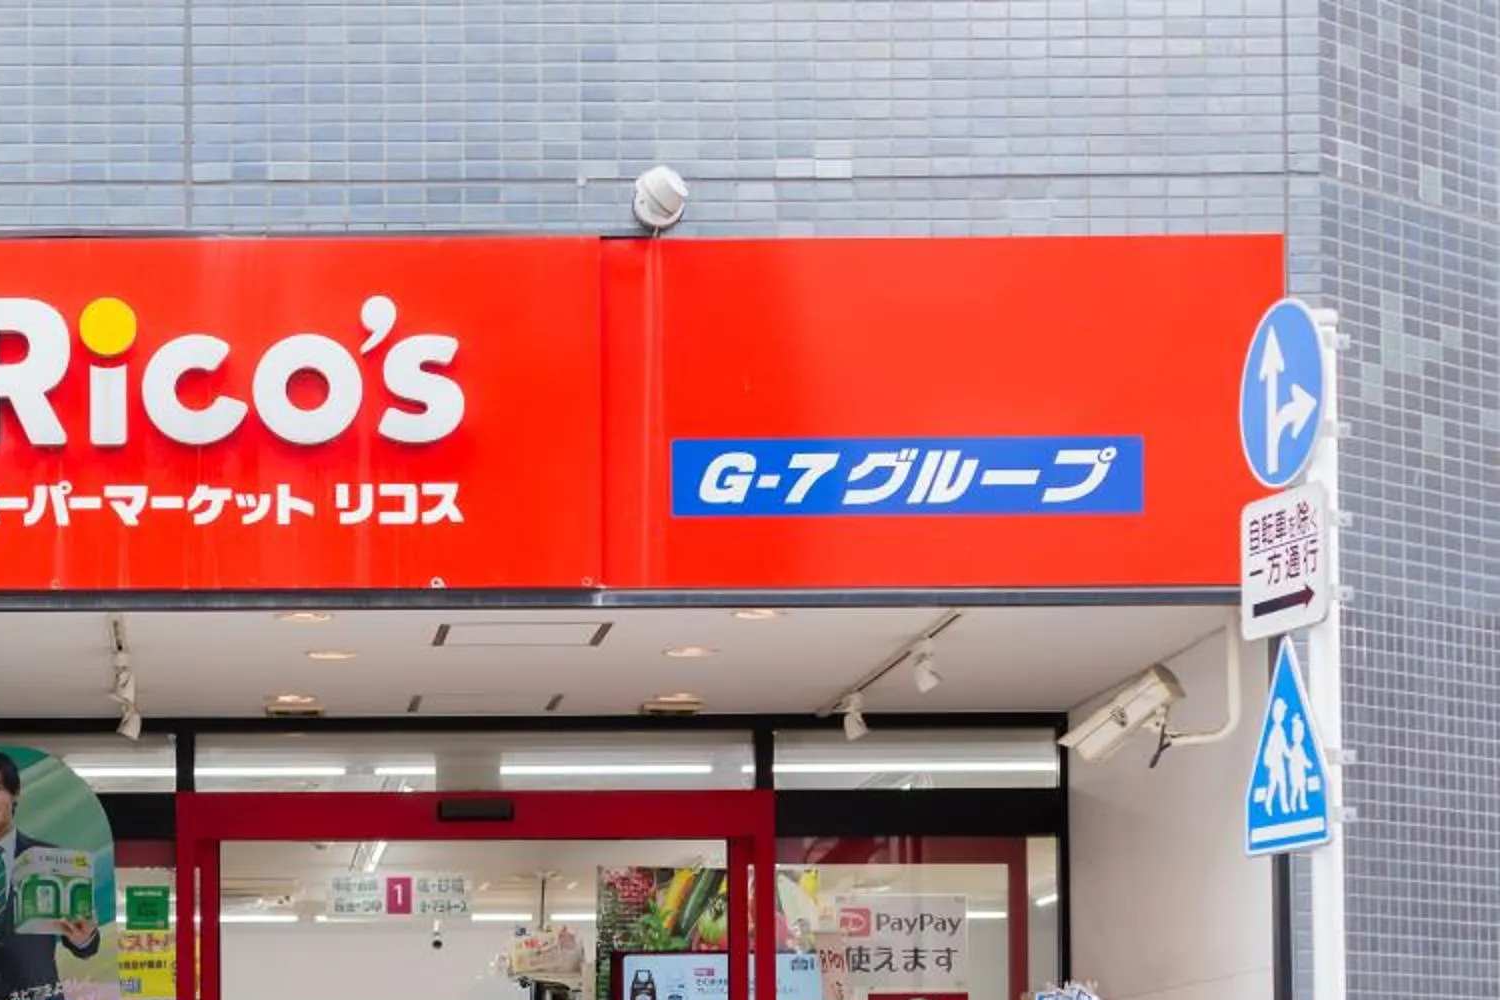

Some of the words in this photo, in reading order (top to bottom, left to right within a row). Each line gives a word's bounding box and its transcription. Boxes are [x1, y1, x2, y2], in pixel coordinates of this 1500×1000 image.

[334, 481, 465, 526] リコス
[1248, 500, 1318, 551] 自転車を除く
[1248, 538, 1319, 585] 一方通行
[875, 912, 962, 936] PayPay
[844, 945, 959, 973] 使えます
